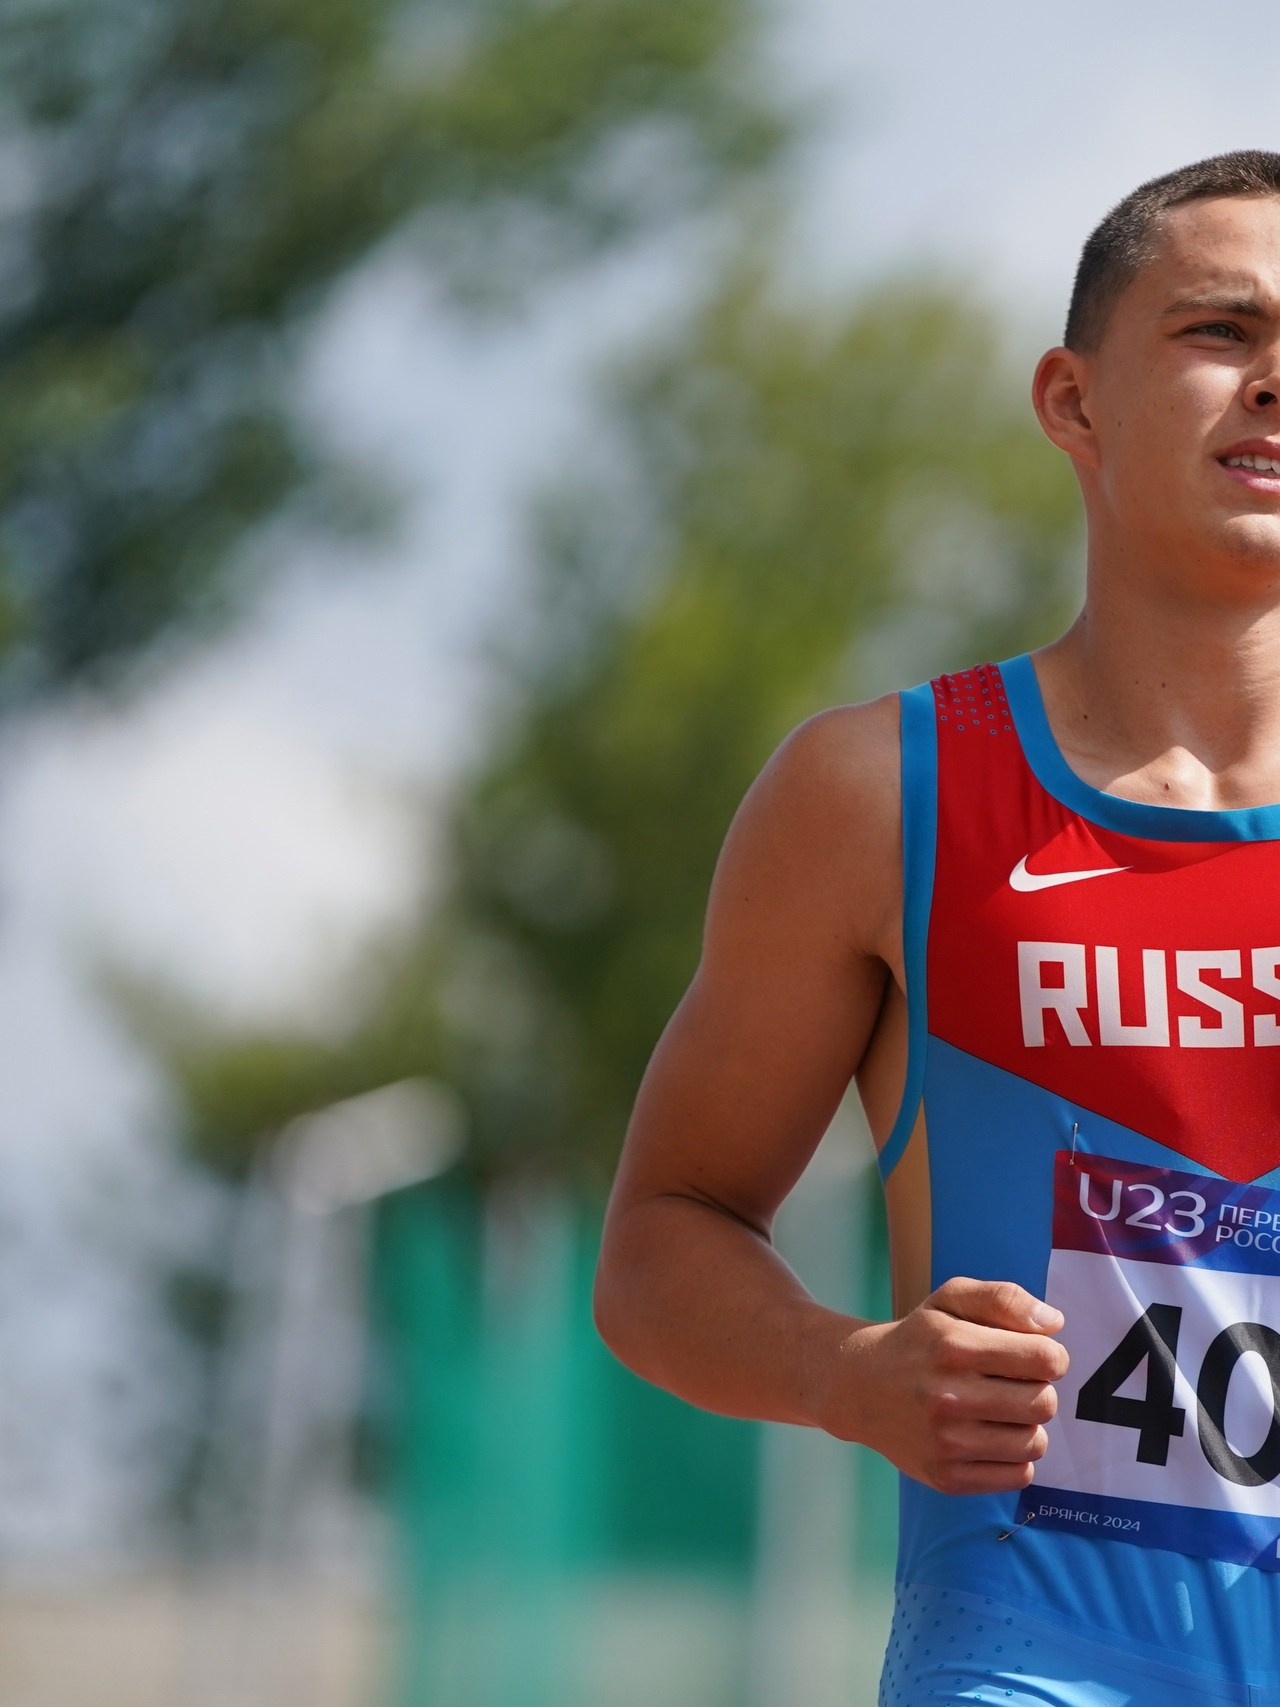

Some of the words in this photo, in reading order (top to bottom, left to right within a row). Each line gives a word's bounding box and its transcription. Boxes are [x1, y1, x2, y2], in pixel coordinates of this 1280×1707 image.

[1078, 1172, 1206, 1239] U23
[1038, 1504, 1100, 1525] БРЯНСК
[1102, 1515, 1142, 1533] 2024
